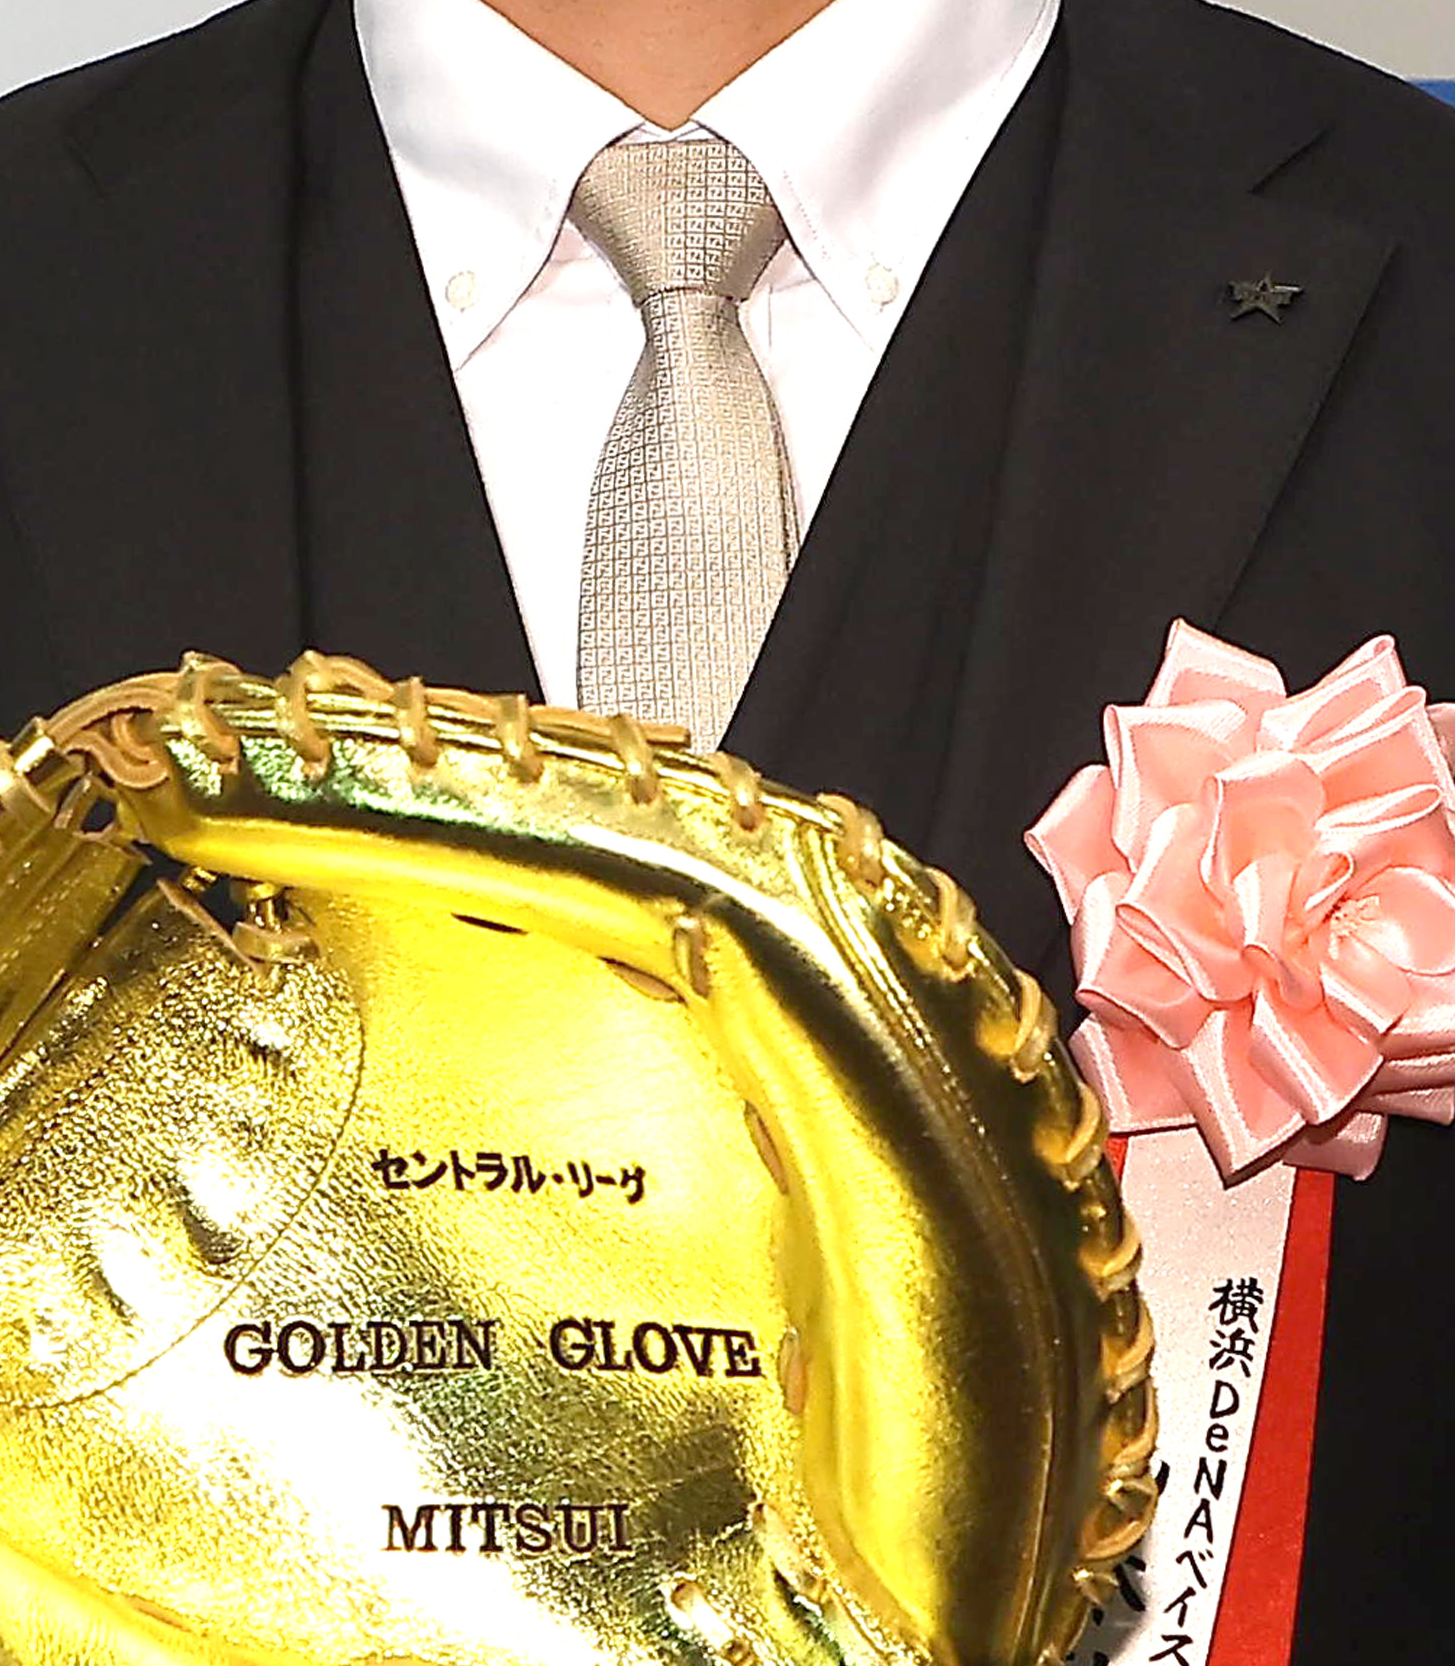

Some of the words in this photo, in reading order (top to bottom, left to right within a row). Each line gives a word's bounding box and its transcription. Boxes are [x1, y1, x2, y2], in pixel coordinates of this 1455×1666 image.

[370, 1148, 647, 1205] セントラル・リーグ
[224, 1318, 500, 1376] GOLDEN
[548, 1316, 763, 1378] GLOVE
[382, 1502, 634, 1559] MITSUI
